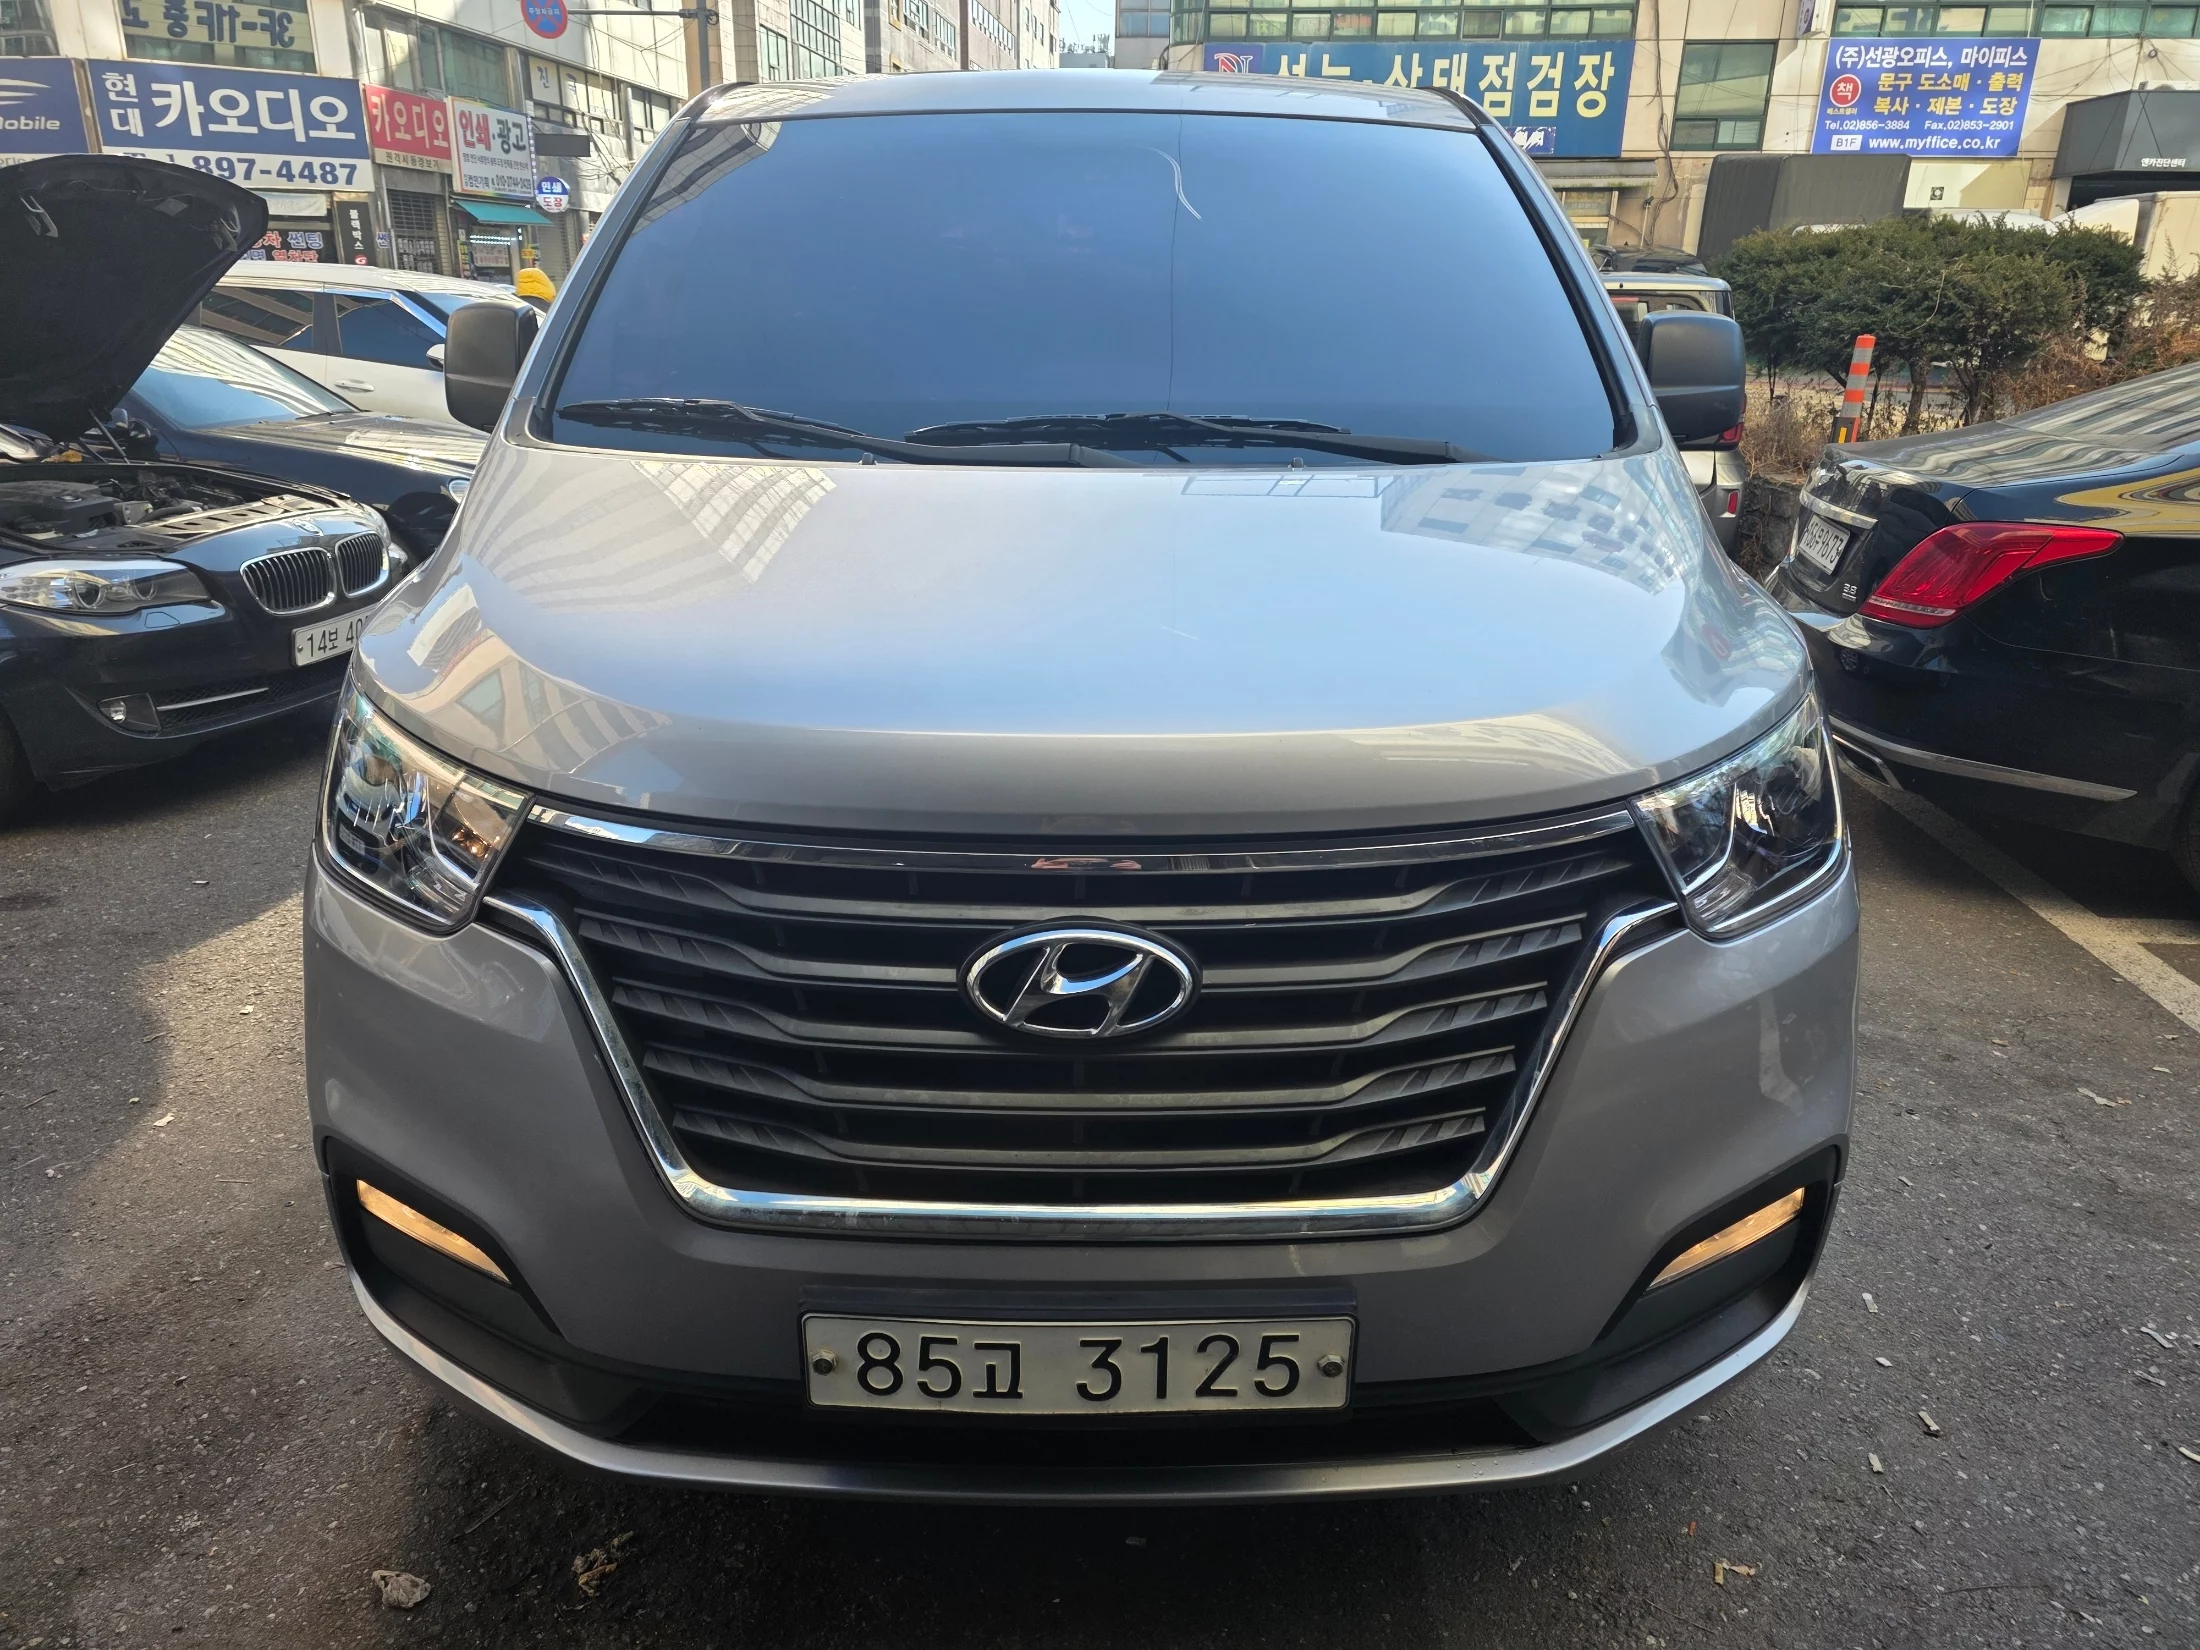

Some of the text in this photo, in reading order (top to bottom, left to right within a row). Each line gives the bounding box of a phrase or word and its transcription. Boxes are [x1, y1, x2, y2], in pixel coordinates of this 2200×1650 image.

[1835, 46, 2028, 69] (주)선광오피스, 마이피스
[1836, 82, 1854, 100] 책
[1877, 73, 2024, 92] 문구 도소매 출력
[102, 72, 145, 138] 현대
[151, 81, 356, 143] 카오디오
[1873, 97, 2017, 116] 복사 제본 도장
[0, 116, 60, 130] obile
[371, 94, 449, 149] 카오디오
[1825, 120, 2015, 131] Tel.02)856-3884 Fax.02)853-2901
[1835, 135, 2001, 150] B1F www.myffice.co.kr
[192, 155, 357, 186] 897-4487
[541, 181, 562, 193] 인쇄
[543, 197, 563, 208] 도장
[349, 209, 364, 250] 블랙박스
[287, 231, 324, 249] 썬팅
[306, 627, 338, 658] 14보
[856, 1333, 1301, 1402] 85고 3125
